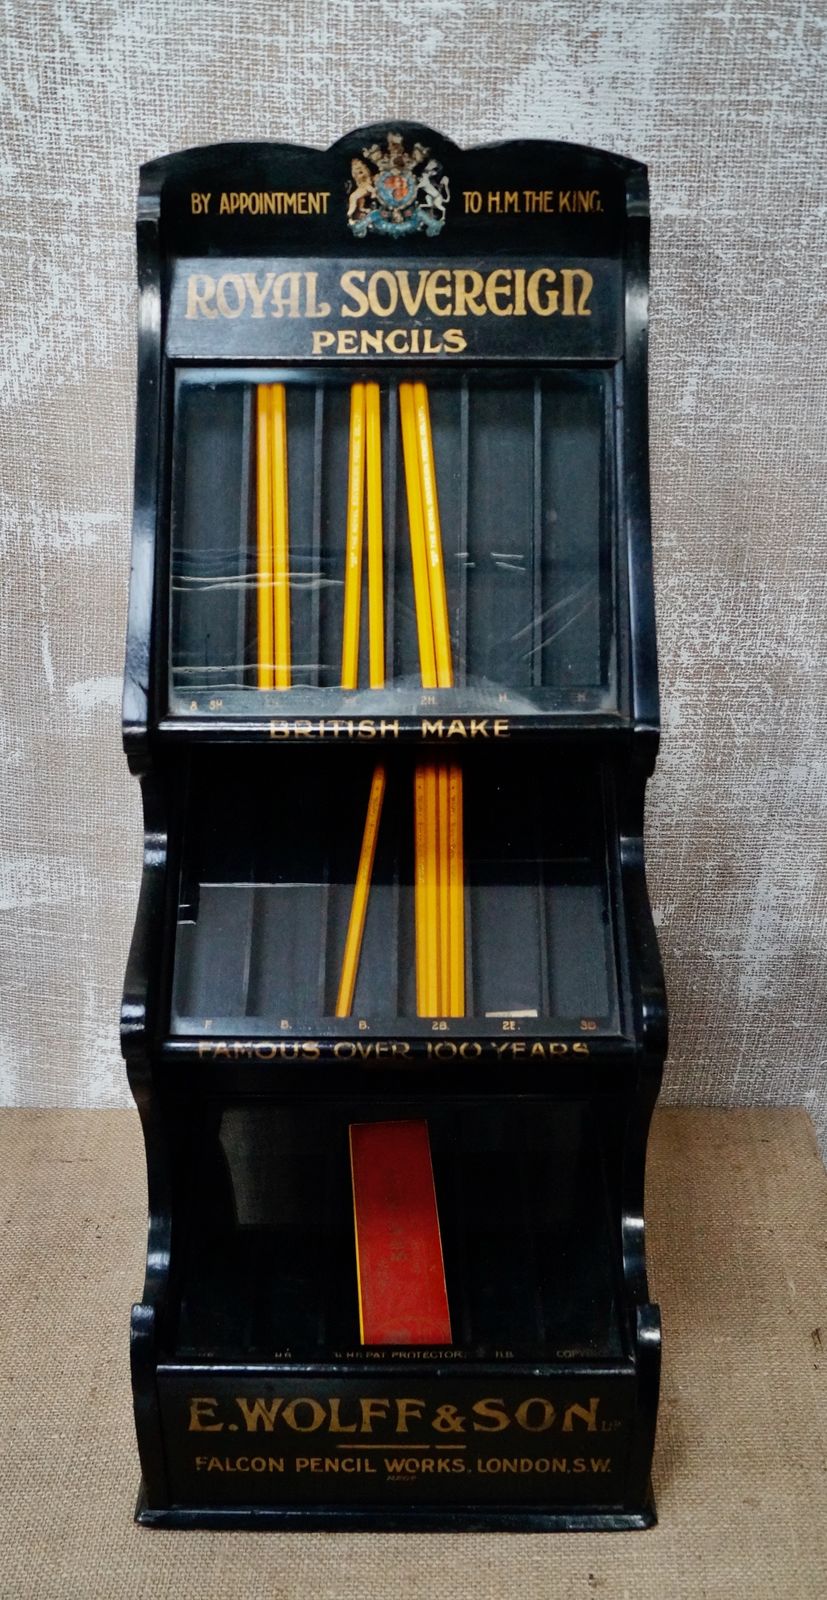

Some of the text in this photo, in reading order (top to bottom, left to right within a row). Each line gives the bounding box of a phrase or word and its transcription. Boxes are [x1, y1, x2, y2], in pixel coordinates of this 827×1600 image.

[191, 191, 331, 215] BY APPOINTMENT
[463, 191, 482, 213] TO
[184, 268, 594, 320] ROYAL SOVEREIGN
[311, 328, 468, 355] PENCILS
[269, 719, 511, 739] BRITISH MAKE
[198, 1041, 321, 1060] FAMOUS
[334, 1041, 411, 1060] OVER
[490, 1041, 589, 1061] YEARS
[195, 1456, 285, 1472] FALCON
[296, 1457, 377, 1473] PENCIL
